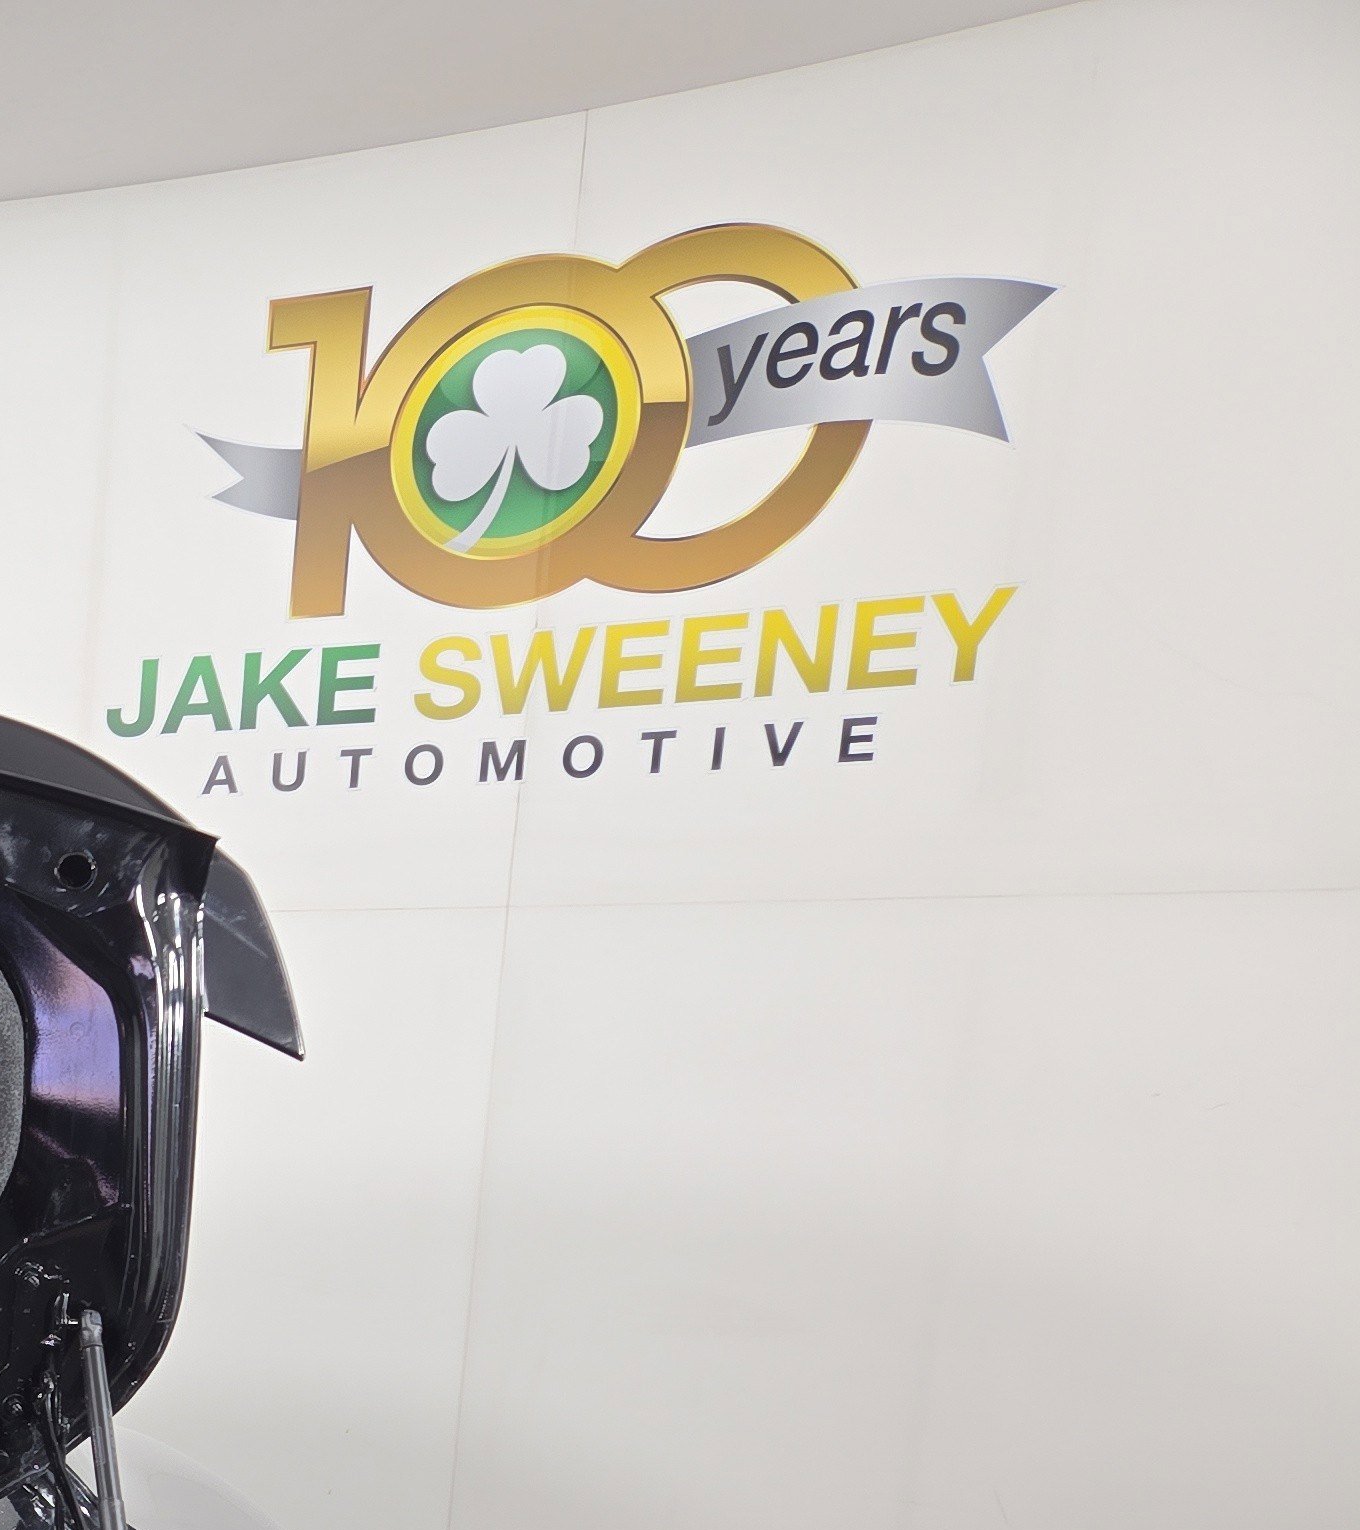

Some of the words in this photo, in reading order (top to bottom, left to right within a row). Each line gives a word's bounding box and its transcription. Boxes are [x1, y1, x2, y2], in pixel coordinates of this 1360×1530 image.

[706, 300, 967, 426] years
[106, 643, 381, 739] JAKE
[413, 586, 1018, 722] SWEENEY
[202, 716, 879, 796] AUTOMOTIVE
